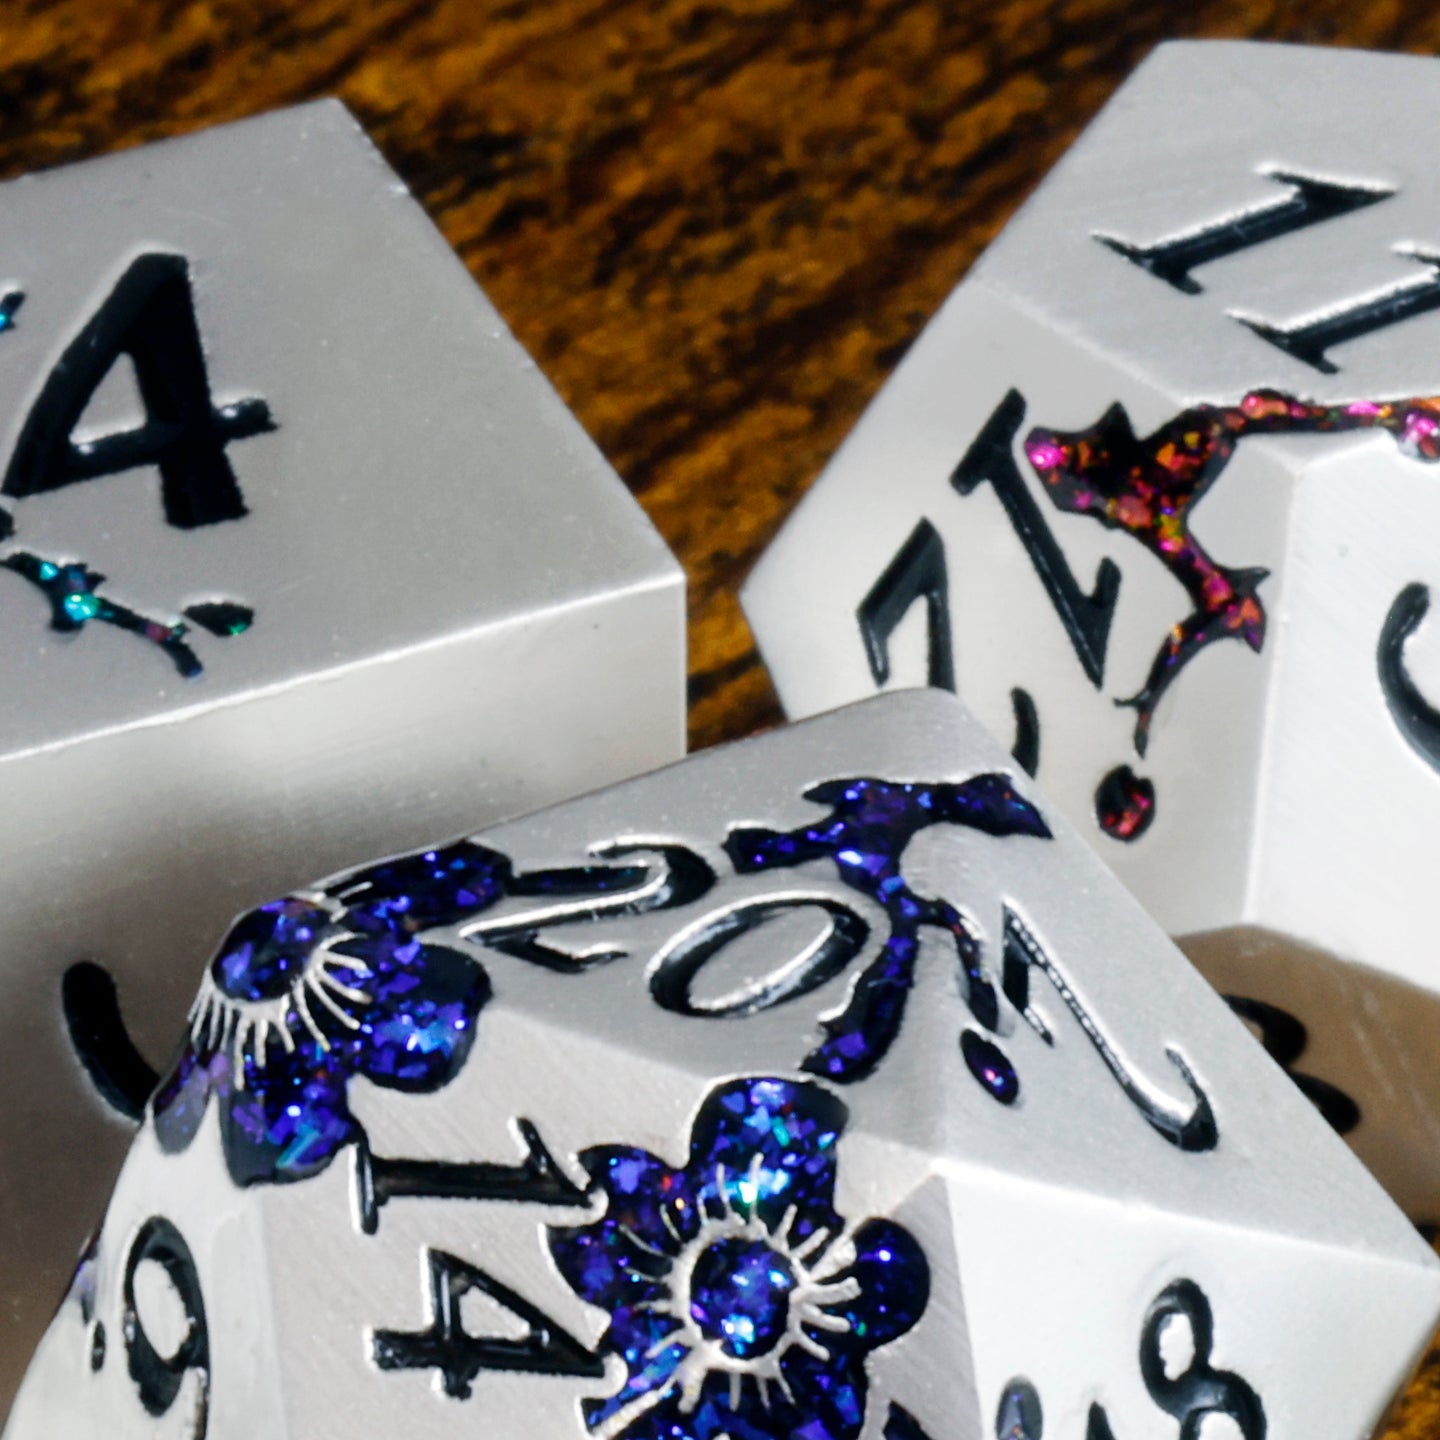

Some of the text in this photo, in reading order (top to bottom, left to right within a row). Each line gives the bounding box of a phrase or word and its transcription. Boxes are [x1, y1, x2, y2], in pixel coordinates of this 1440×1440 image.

[0, 250, 278, 530] 4
[460, 834, 872, 1016] 20
[354, 1117, 628, 1400] 14
